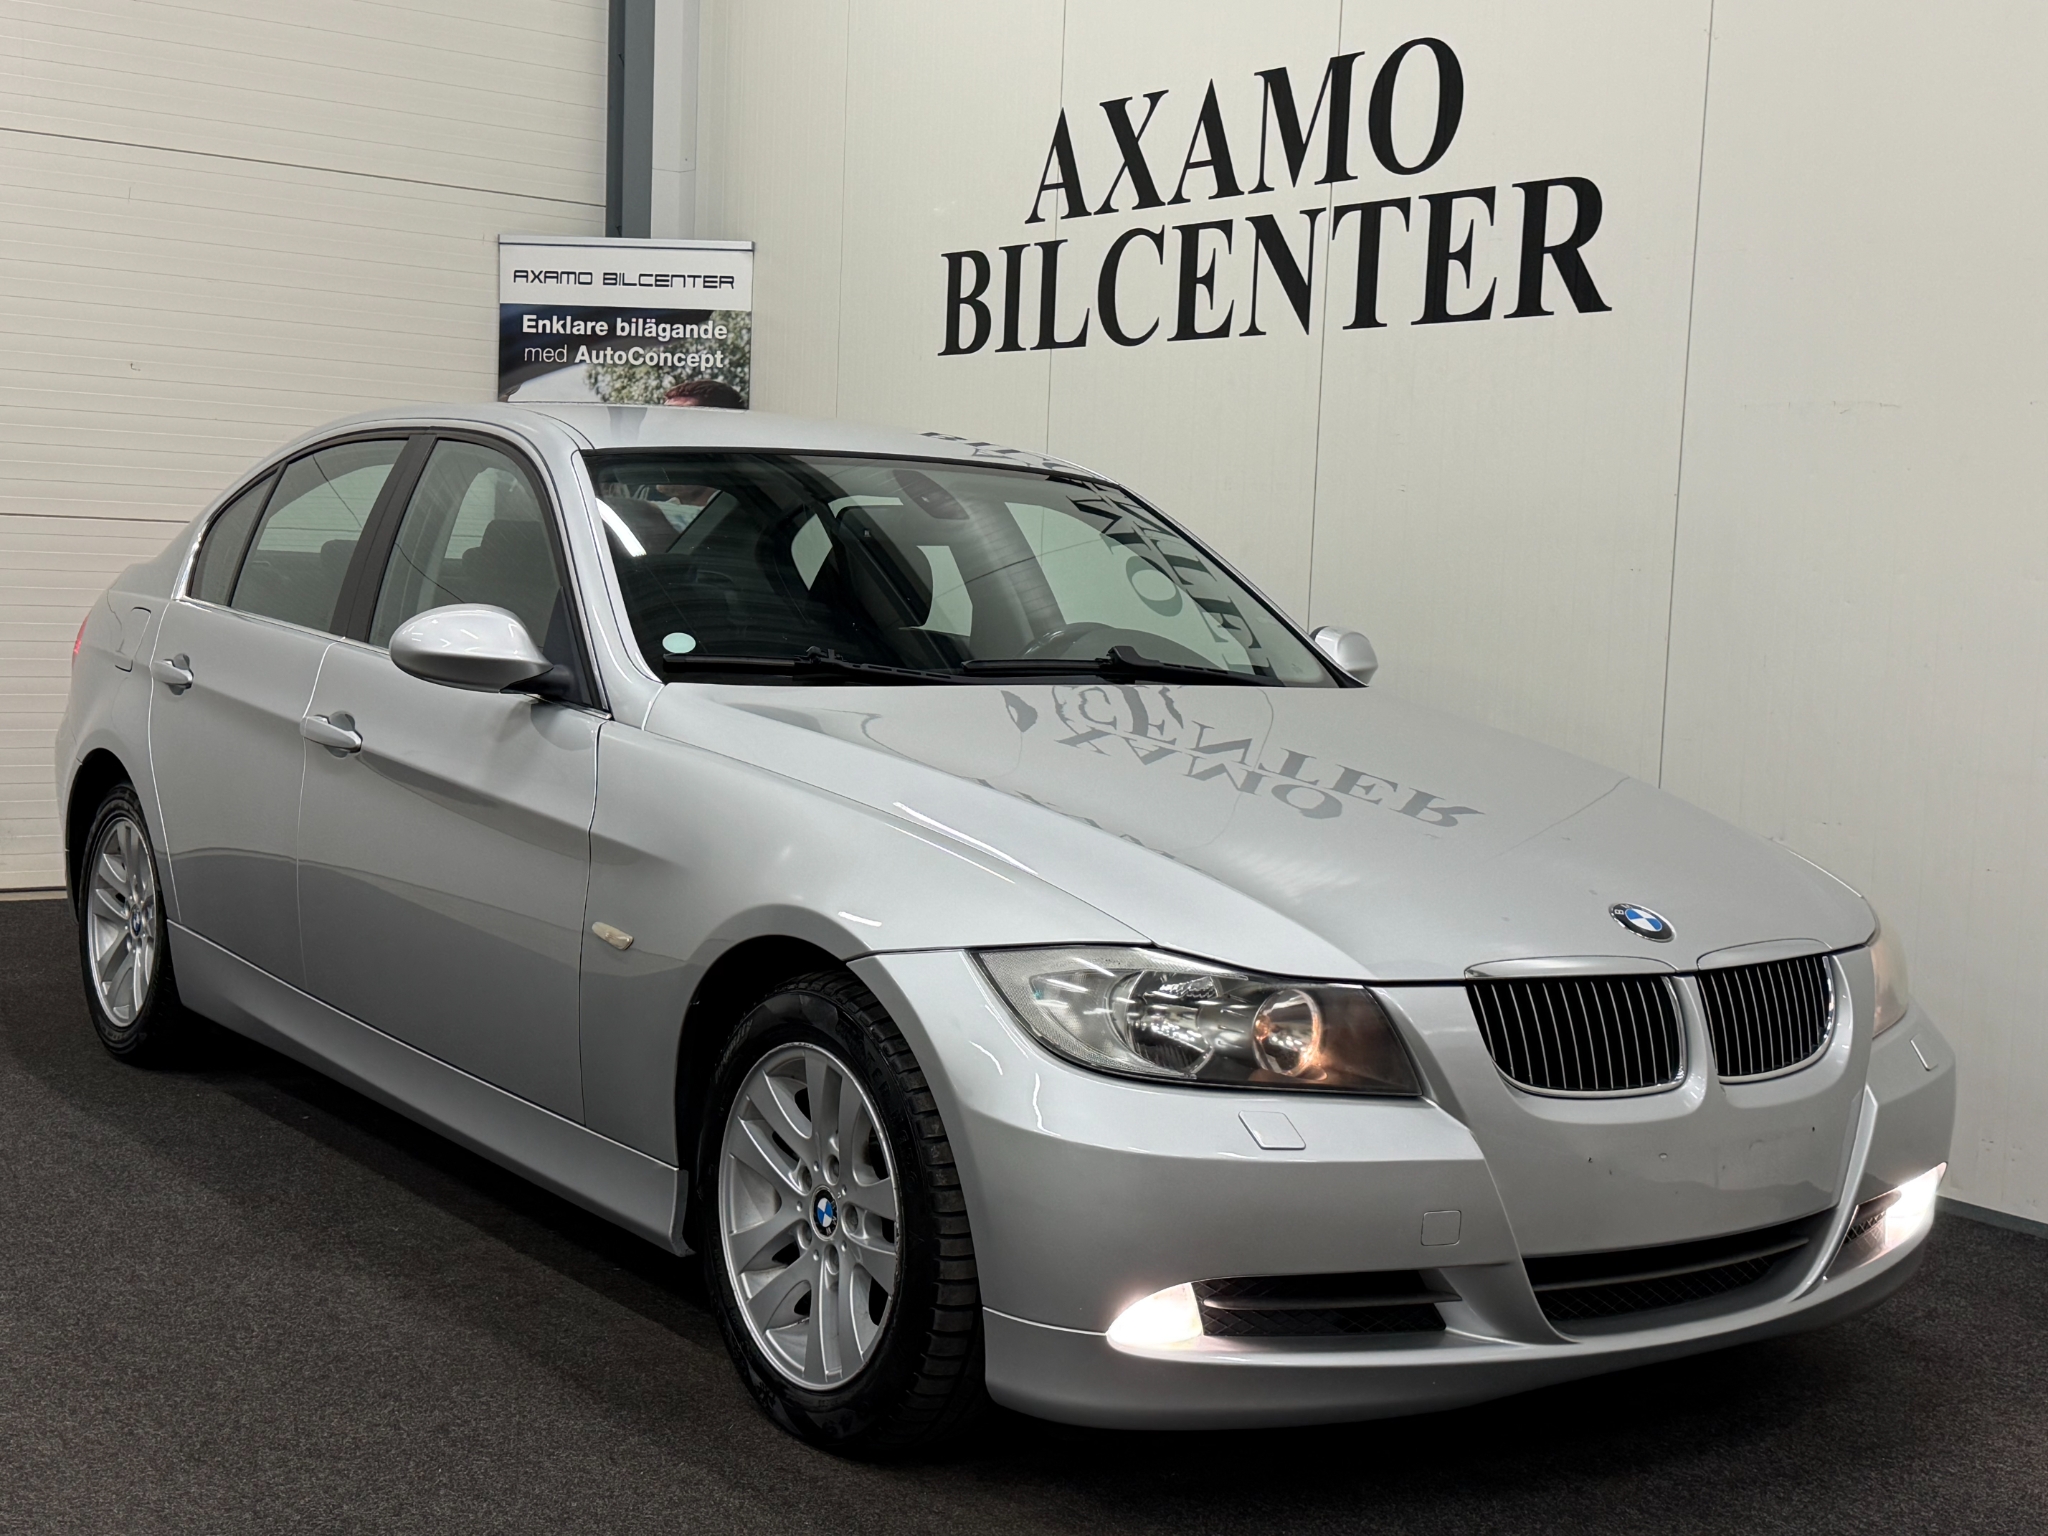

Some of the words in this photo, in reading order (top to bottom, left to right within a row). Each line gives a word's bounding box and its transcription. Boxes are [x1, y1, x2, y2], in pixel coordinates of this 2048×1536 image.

[1024, 37, 1464, 225] AXAMO
[513, 269, 593, 285] AXAMO
[602, 272, 735, 289] BILCENTER
[937, 176, 1613, 357] BILCENTER
[522, 314, 609, 336] Enklare
[616, 317, 728, 342] bilägande
[524, 344, 568, 363] med
[574, 345, 724, 371] AutoConcept
